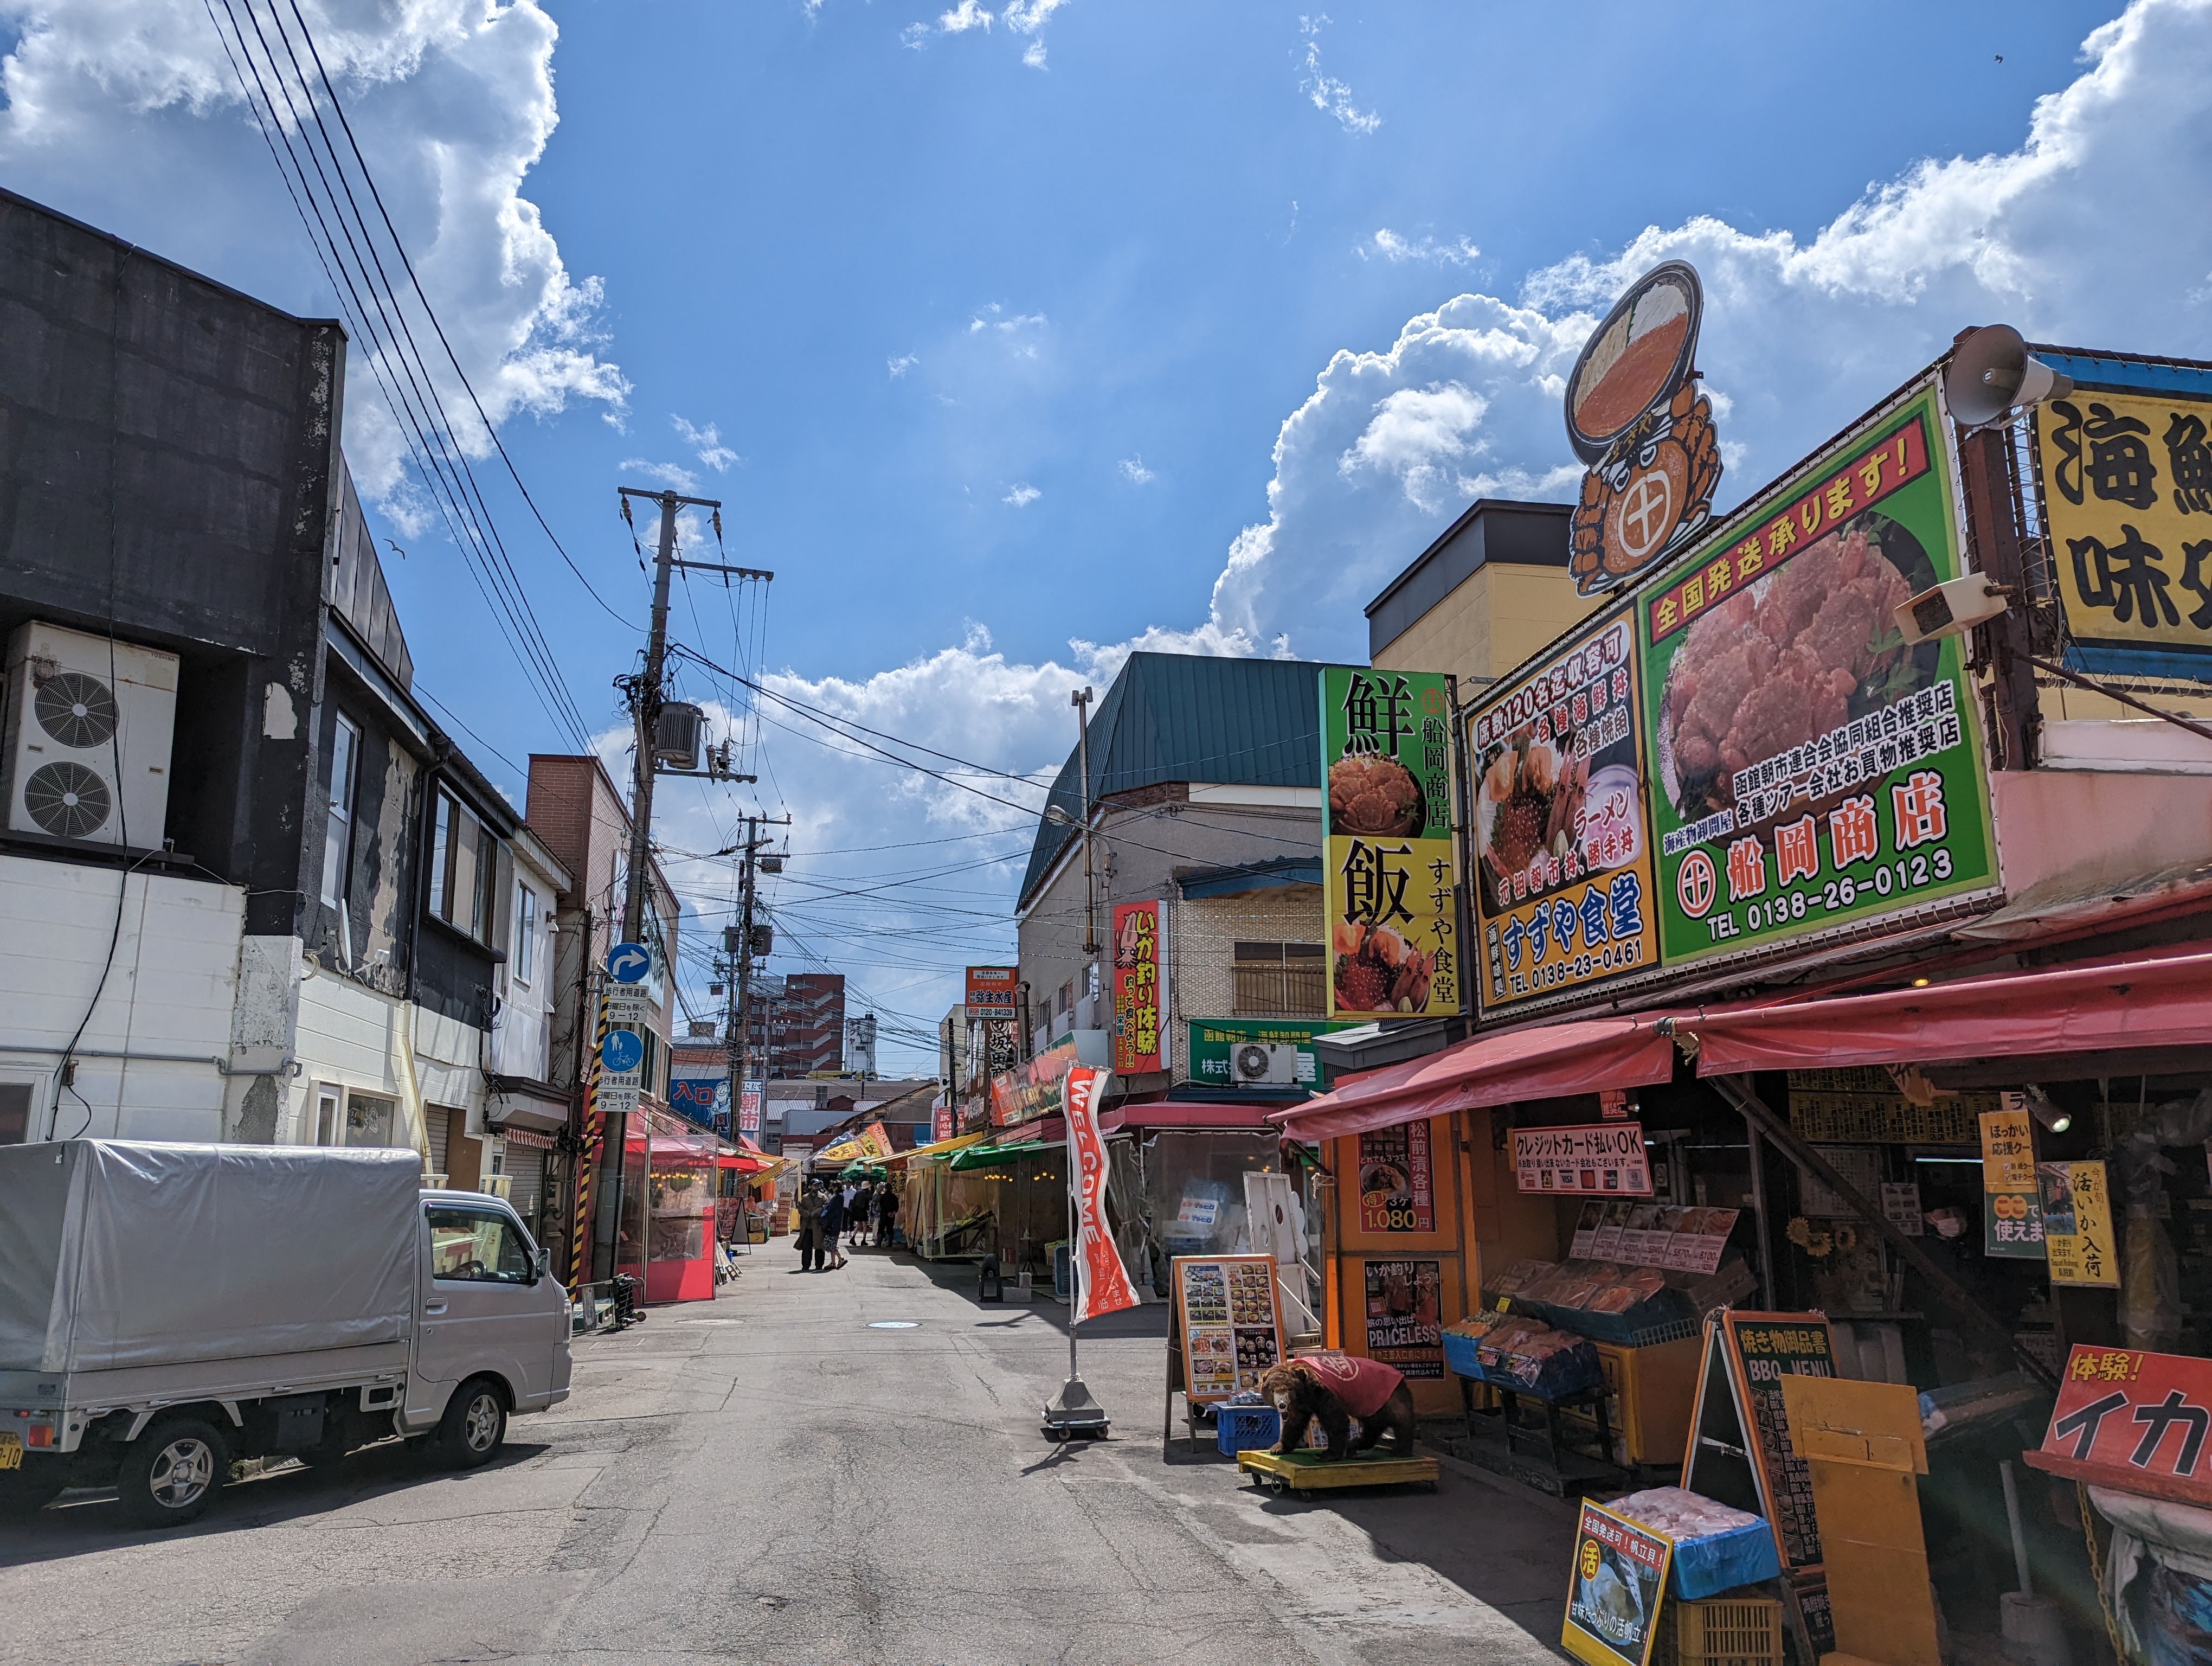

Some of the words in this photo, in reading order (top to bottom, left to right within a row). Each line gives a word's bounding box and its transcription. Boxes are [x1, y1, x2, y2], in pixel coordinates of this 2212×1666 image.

[1341, 671, 1414, 759] 鮮
[1538, 668, 1628, 745] 各種海鮮丼
[1575, 706, 1629, 760] 各種焼魚
[1421, 717, 1449, 829] 船岡商店
[1574, 787, 1631, 840] ラーメン
[1663, 811, 1733, 855] 海産物卸問屋
[1726, 771, 1949, 901] 船岡商店
[1341, 837, 1415, 926] 飯
[1707, 913, 1740, 941] TEL
[1747, 849, 1952, 932] 0138-26-0123
[1427, 858, 1456, 1004] すずや食堂
[1502, 871, 1643, 972] すずや食堂
[605, 986, 647, 999] 歩行者用道路
[1136, 910, 1158, 1055] いか釣り体験
[1508, 972, 1529, 996] TEL
[1532, 937, 1643, 990] 0138-23-0461
[1204, 1029, 1246, 1042] 函館朝市
[673, 1081, 713, 1105] 入口
[1201, 1059, 1231, 1074] 株式
[741, 1092, 760, 1130] 朝市
[1411, 1122, 1429, 1207] 松前漬各種
[1516, 1130, 1642, 1156] クレジットカード払いOK
[1992, 1142, 2034, 1156] 応援クー
[2073, 1172, 2102, 1278] 活いか入荷
[1366, 1261, 1414, 1278] いか釣り
[1740, 1329, 1827, 1354] 焼き物御品書
[2070, 1353, 2144, 1382] 体験!
[1748, 1359, 1782, 1381] BBQ
[1583, 1546, 1598, 1576] 活
